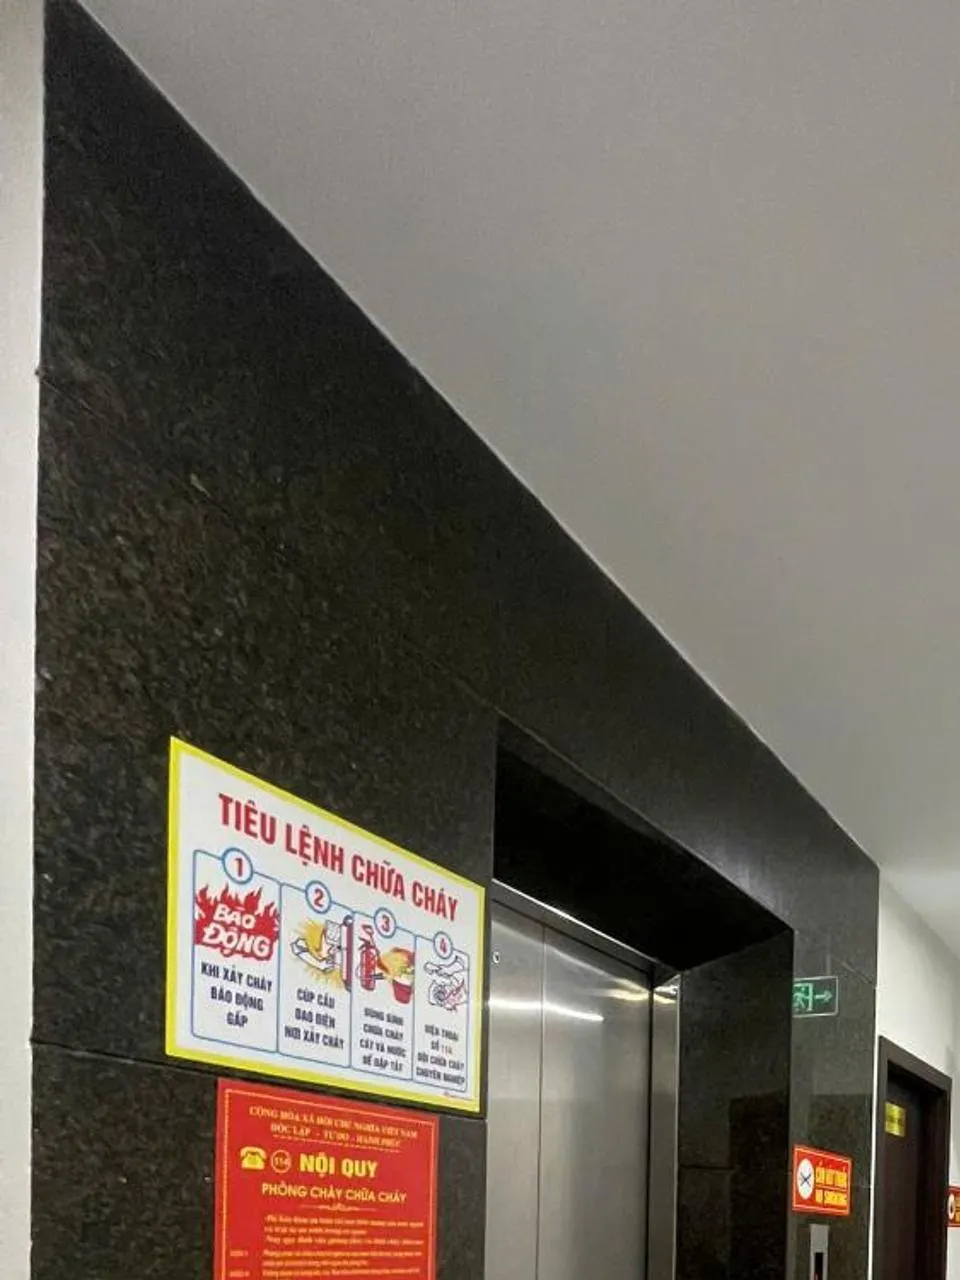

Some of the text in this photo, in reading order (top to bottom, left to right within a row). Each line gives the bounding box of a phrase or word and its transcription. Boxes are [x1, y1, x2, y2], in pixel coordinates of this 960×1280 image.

[218, 793, 458, 922] TIÊU LỆNH CHỮA CHÁY
[234, 858, 243, 877] 1
[314, 888, 324, 908] 2
[382, 914, 390, 932] 3
[202, 922, 271, 958] ĐỘNG
[440, 937, 448, 954] 4
[201, 961, 219, 979] KHI
[300, 1152, 378, 1179] NỘI QUY
[262, 1180, 308, 1198] PHÒNG
